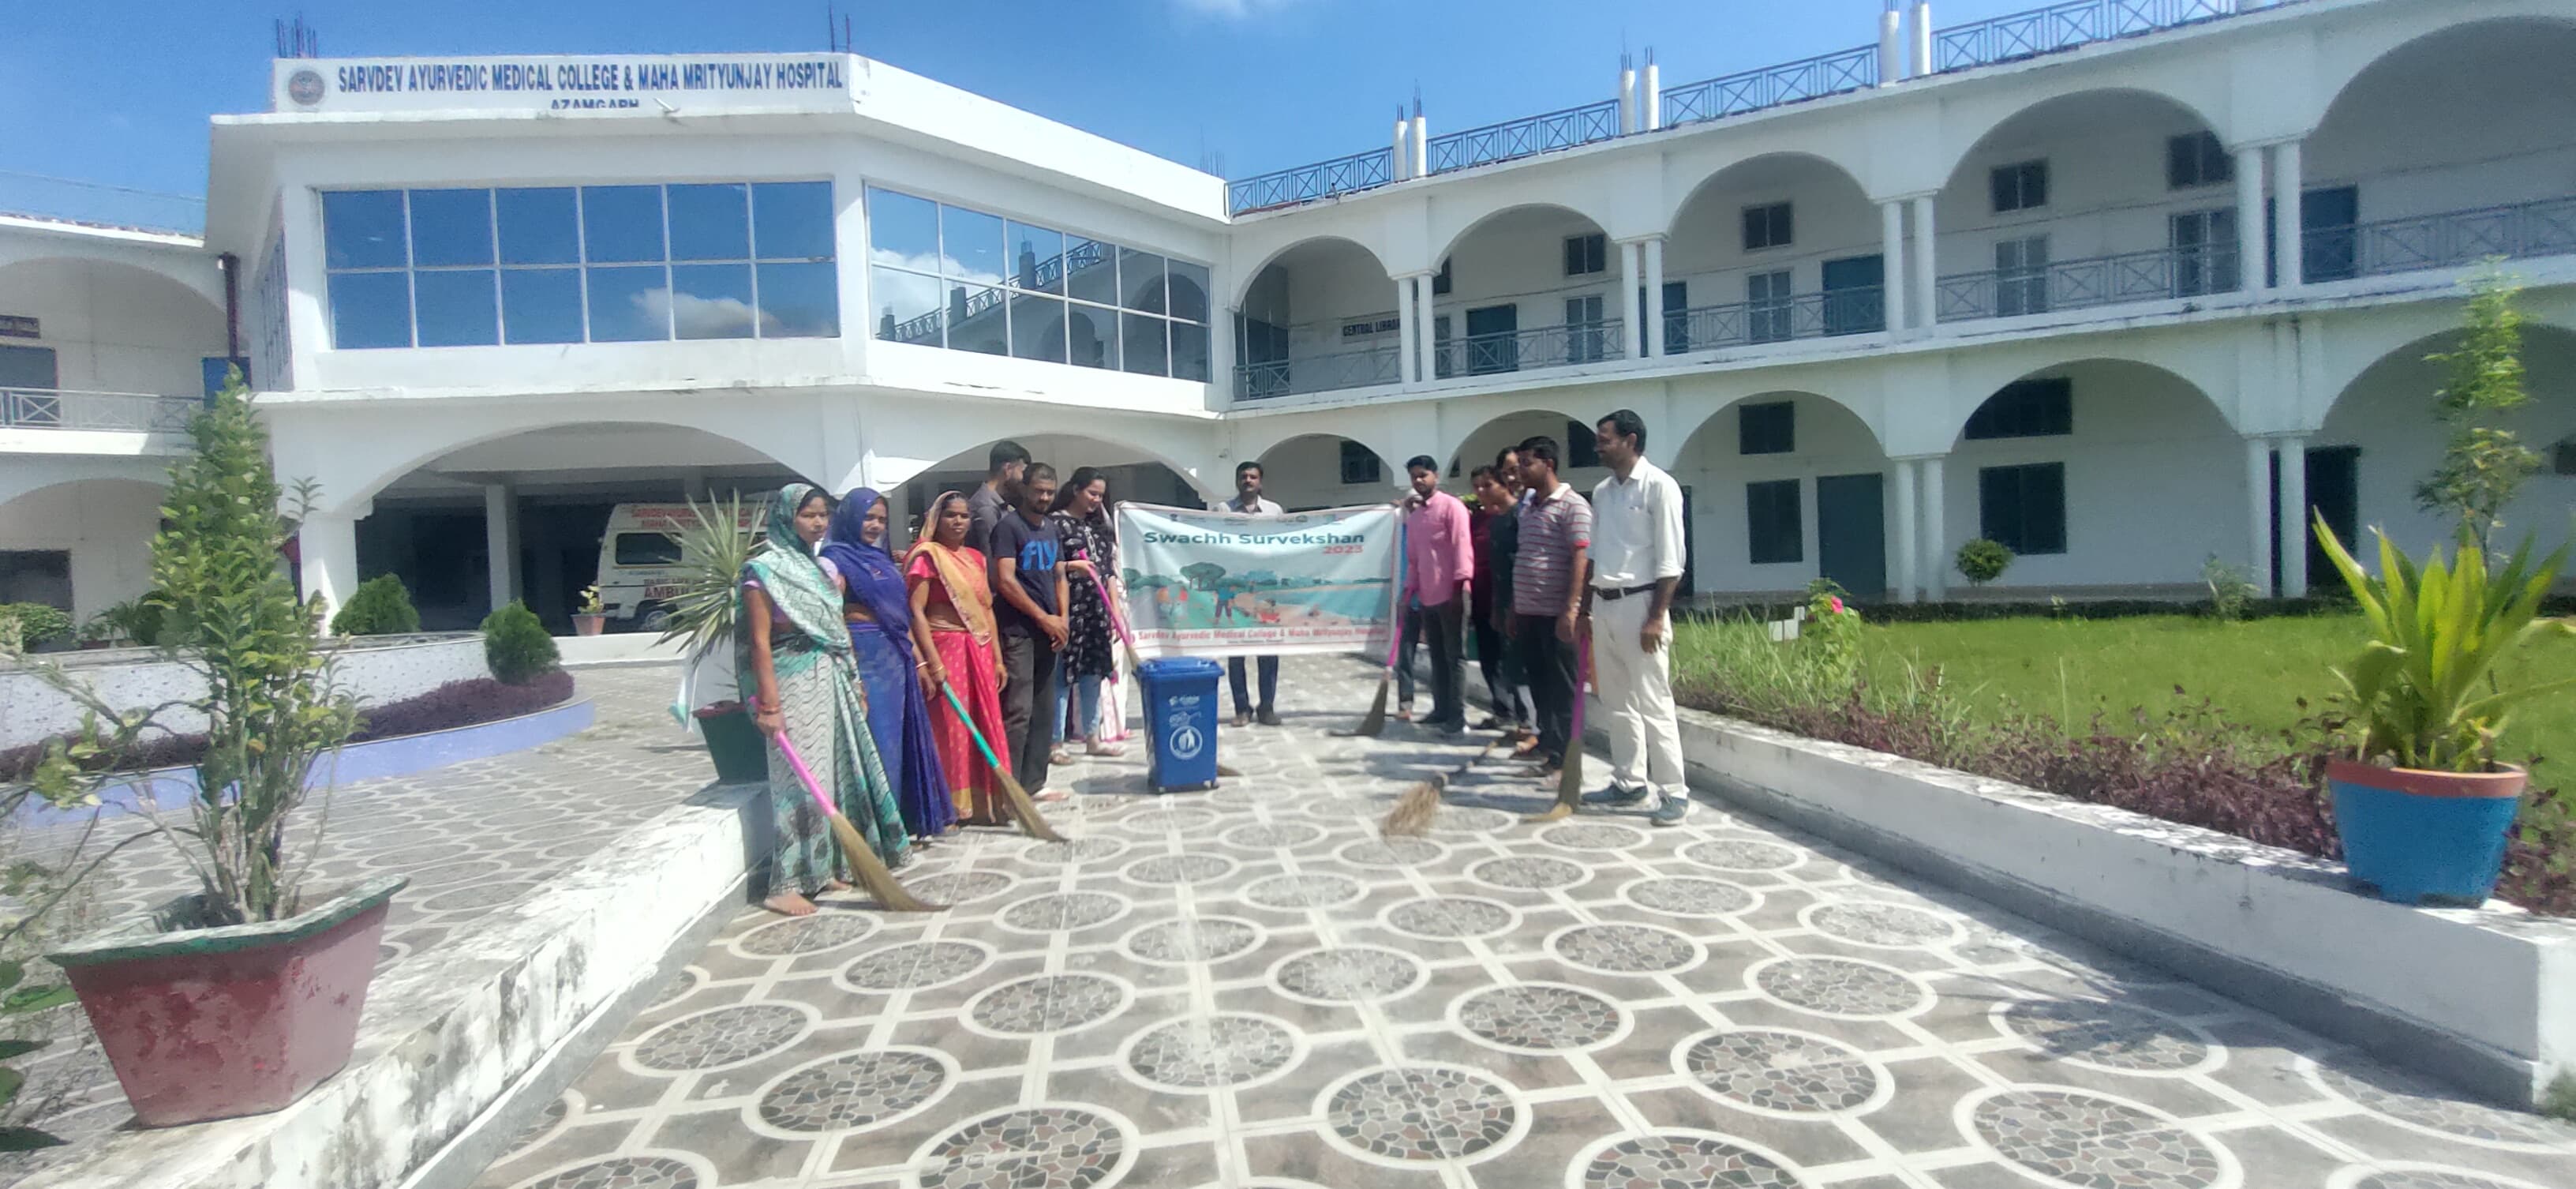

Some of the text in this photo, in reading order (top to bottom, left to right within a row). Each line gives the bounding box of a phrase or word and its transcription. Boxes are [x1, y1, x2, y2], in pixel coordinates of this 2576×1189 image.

[339, 62, 843, 92] SARVDEV AYURVEDIC MEDICAL COLLEGE & MAHA MRITYUNJAY HOSPITAL
[1343, 322, 1373, 336] CENTRAL
[1144, 532, 1365, 546] Swachh Survekshan
[1323, 546, 1364, 555] 2023
[1214, 629, 1245, 639] Medical
[1248, 629, 1277, 639] College
